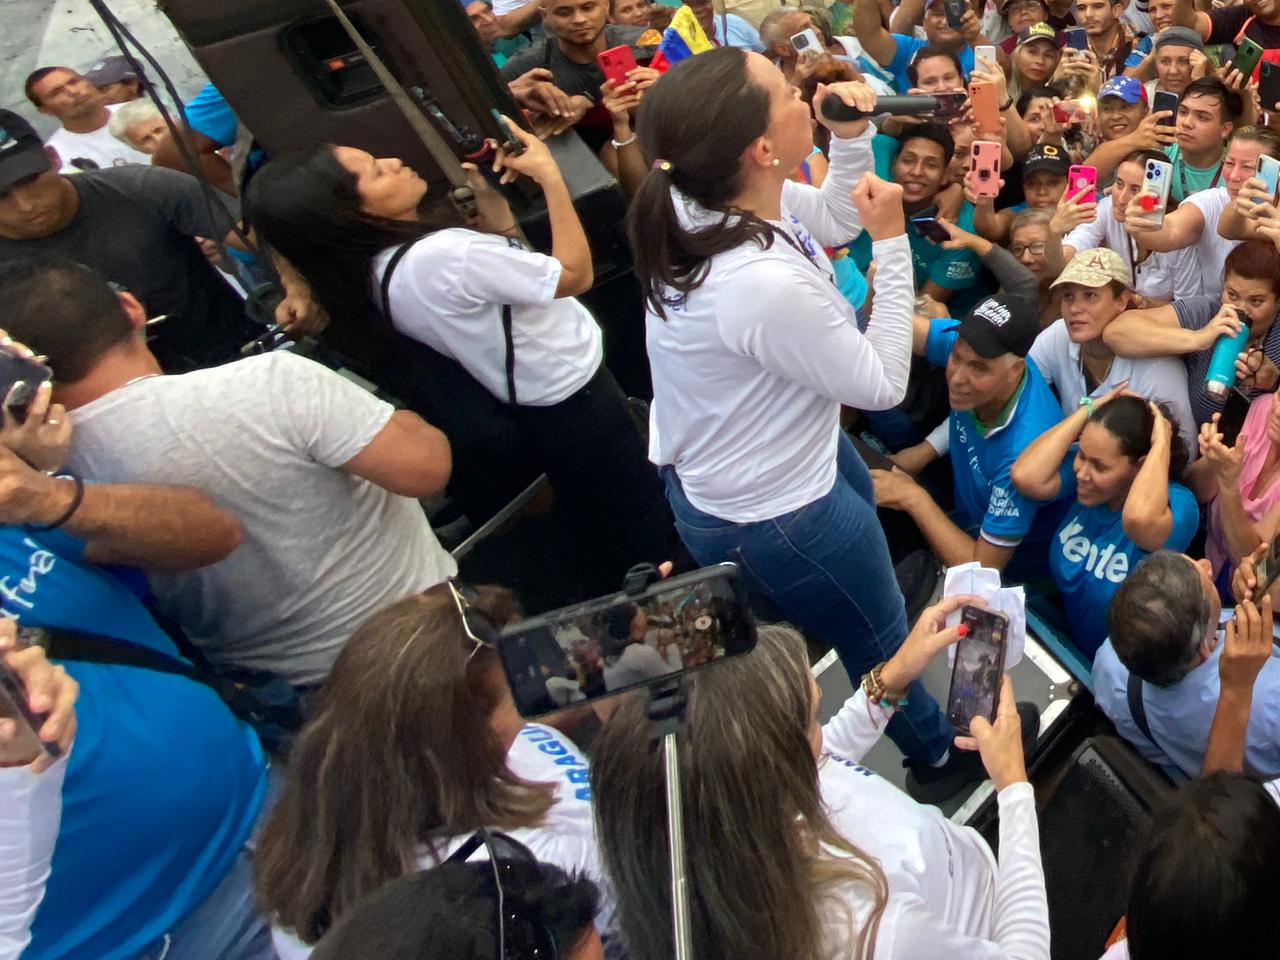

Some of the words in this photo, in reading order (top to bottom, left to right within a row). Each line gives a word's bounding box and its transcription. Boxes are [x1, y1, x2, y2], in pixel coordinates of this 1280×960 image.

[1087, 255, 1106, 270] A
[988, 504, 1020, 517] ORINA
[520, 725, 592, 801] ARAGU
